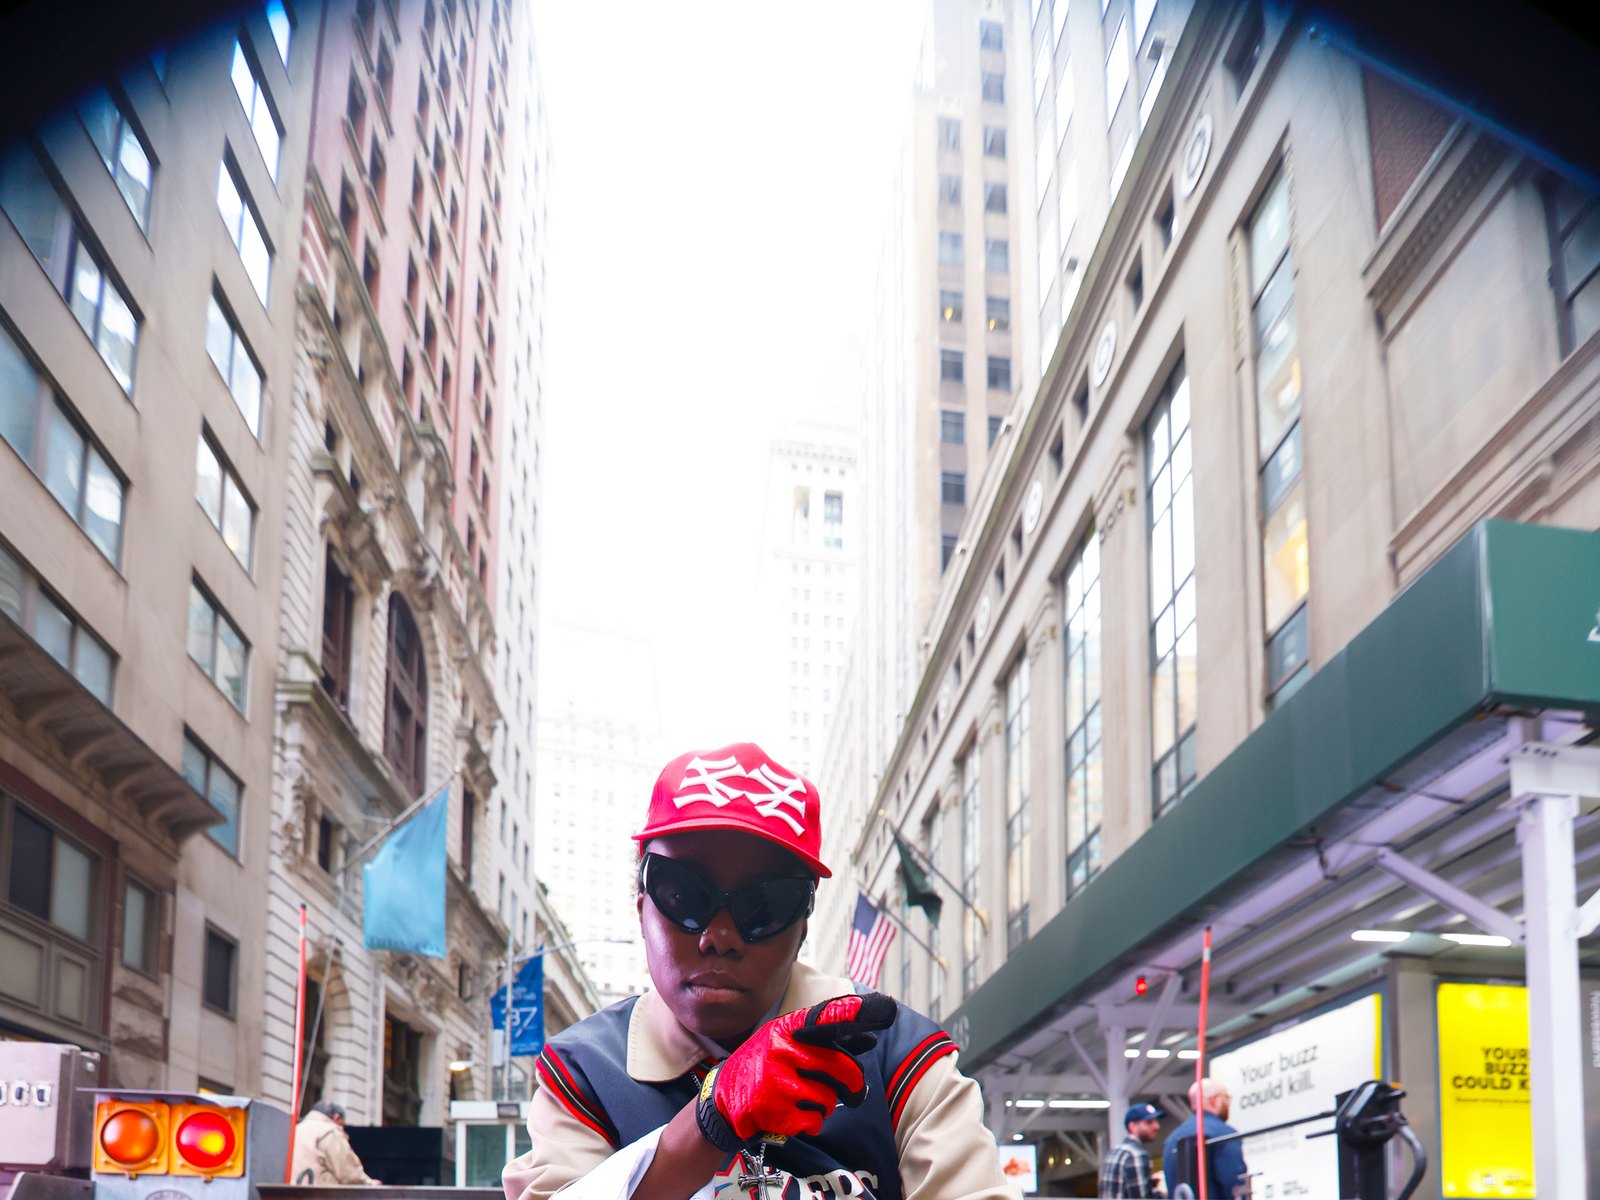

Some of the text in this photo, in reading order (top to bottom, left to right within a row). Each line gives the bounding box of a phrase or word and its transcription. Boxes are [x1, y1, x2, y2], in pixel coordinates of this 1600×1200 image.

[501, 1007, 537, 1038] 37
[1240, 1045, 1317, 1085] Your buzz
[1482, 1047, 1528, 1060] YOUR
[1485, 1062, 1528, 1075] BUZZ
[1240, 1069, 1315, 1109] could kill.
[1452, 1075, 1511, 1090] COULD
